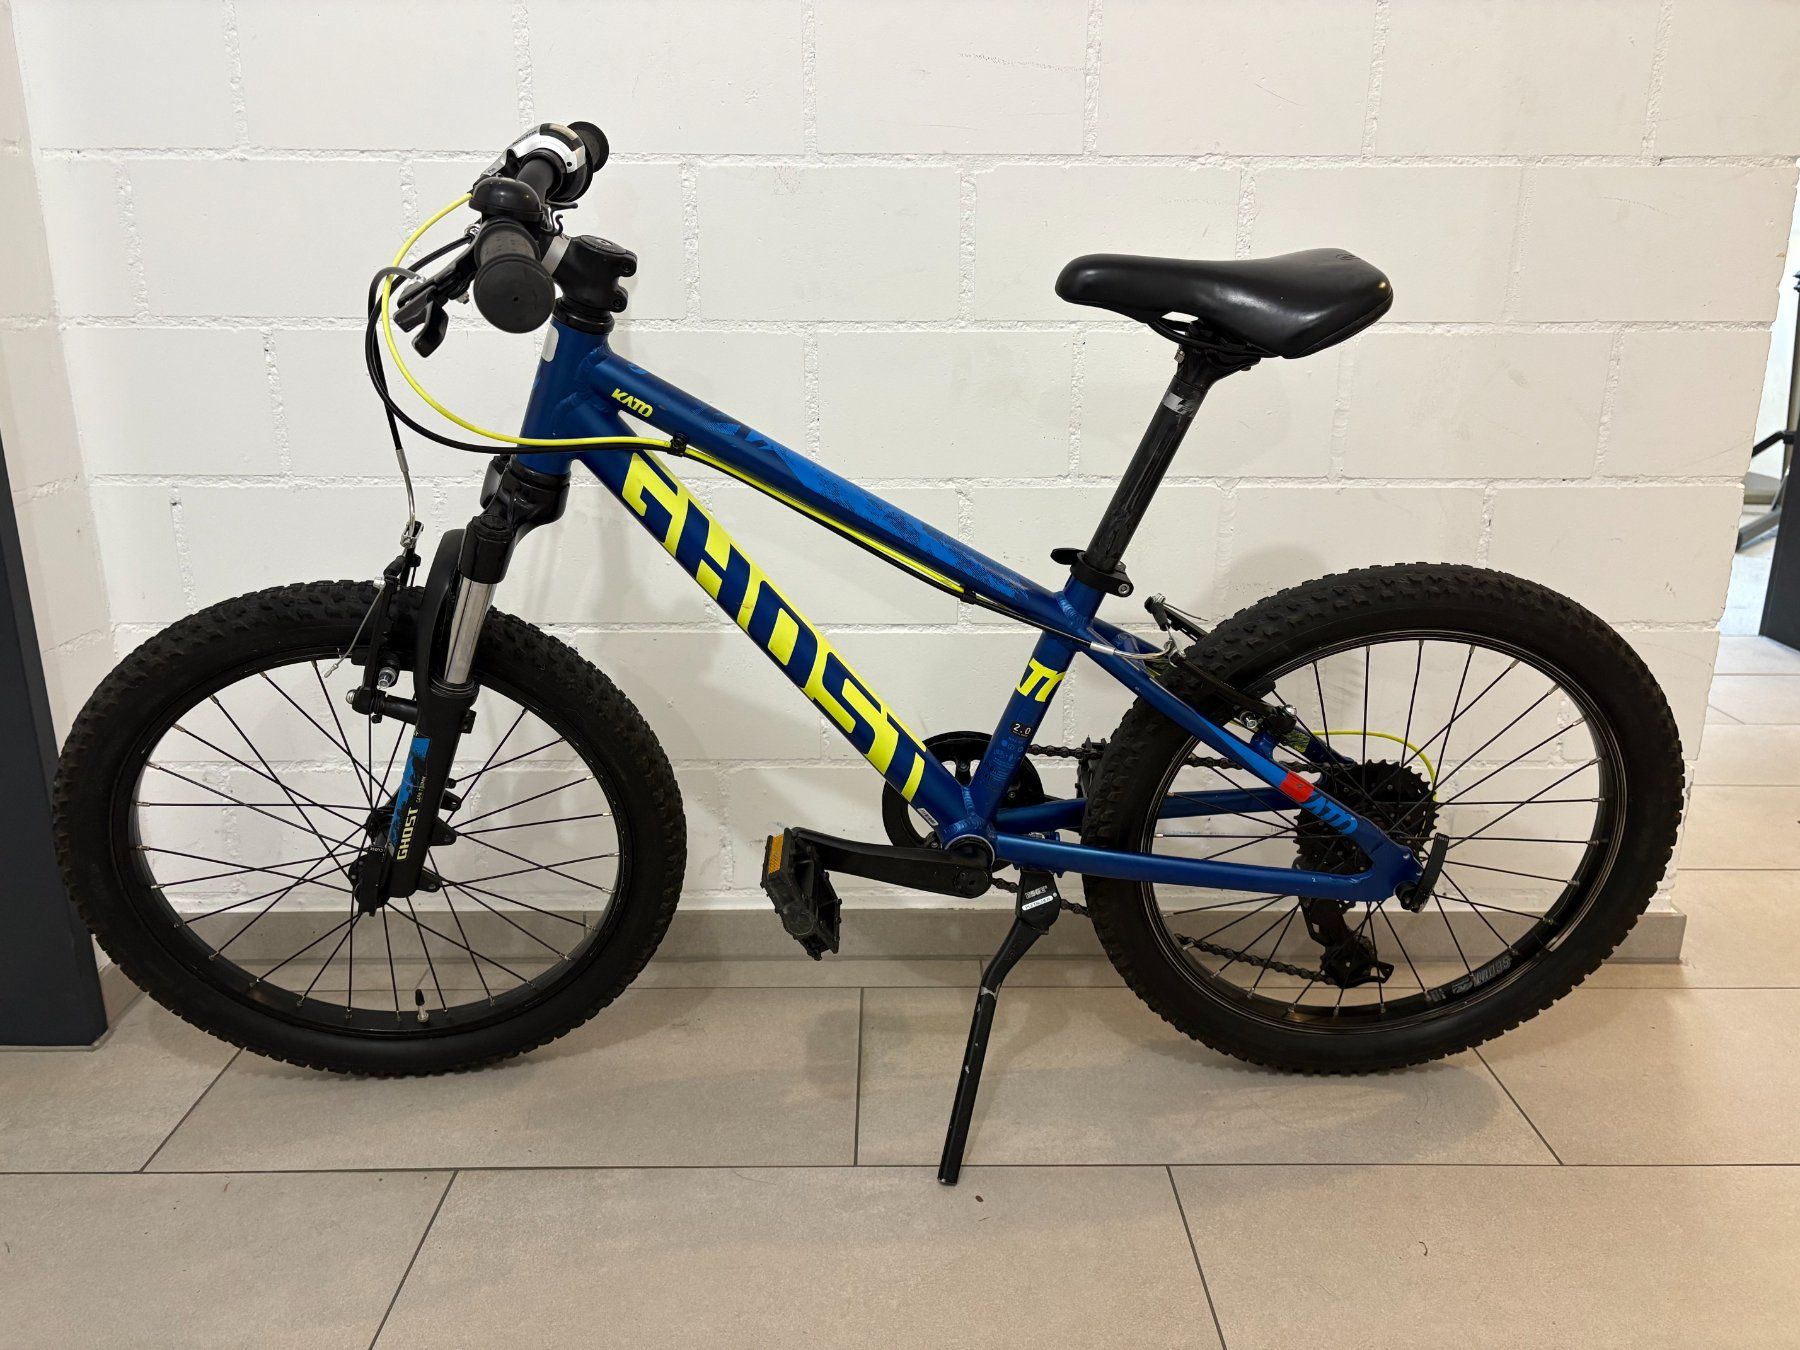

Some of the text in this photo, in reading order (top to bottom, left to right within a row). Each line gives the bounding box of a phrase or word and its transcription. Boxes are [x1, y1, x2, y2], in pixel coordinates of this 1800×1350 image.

[611, 387, 654, 418] KATO
[618, 447, 928, 804] GHOST
[1013, 723, 1031, 735] 2.0
[396, 806, 419, 860] GHOST
[1300, 790, 1359, 835] ATO
